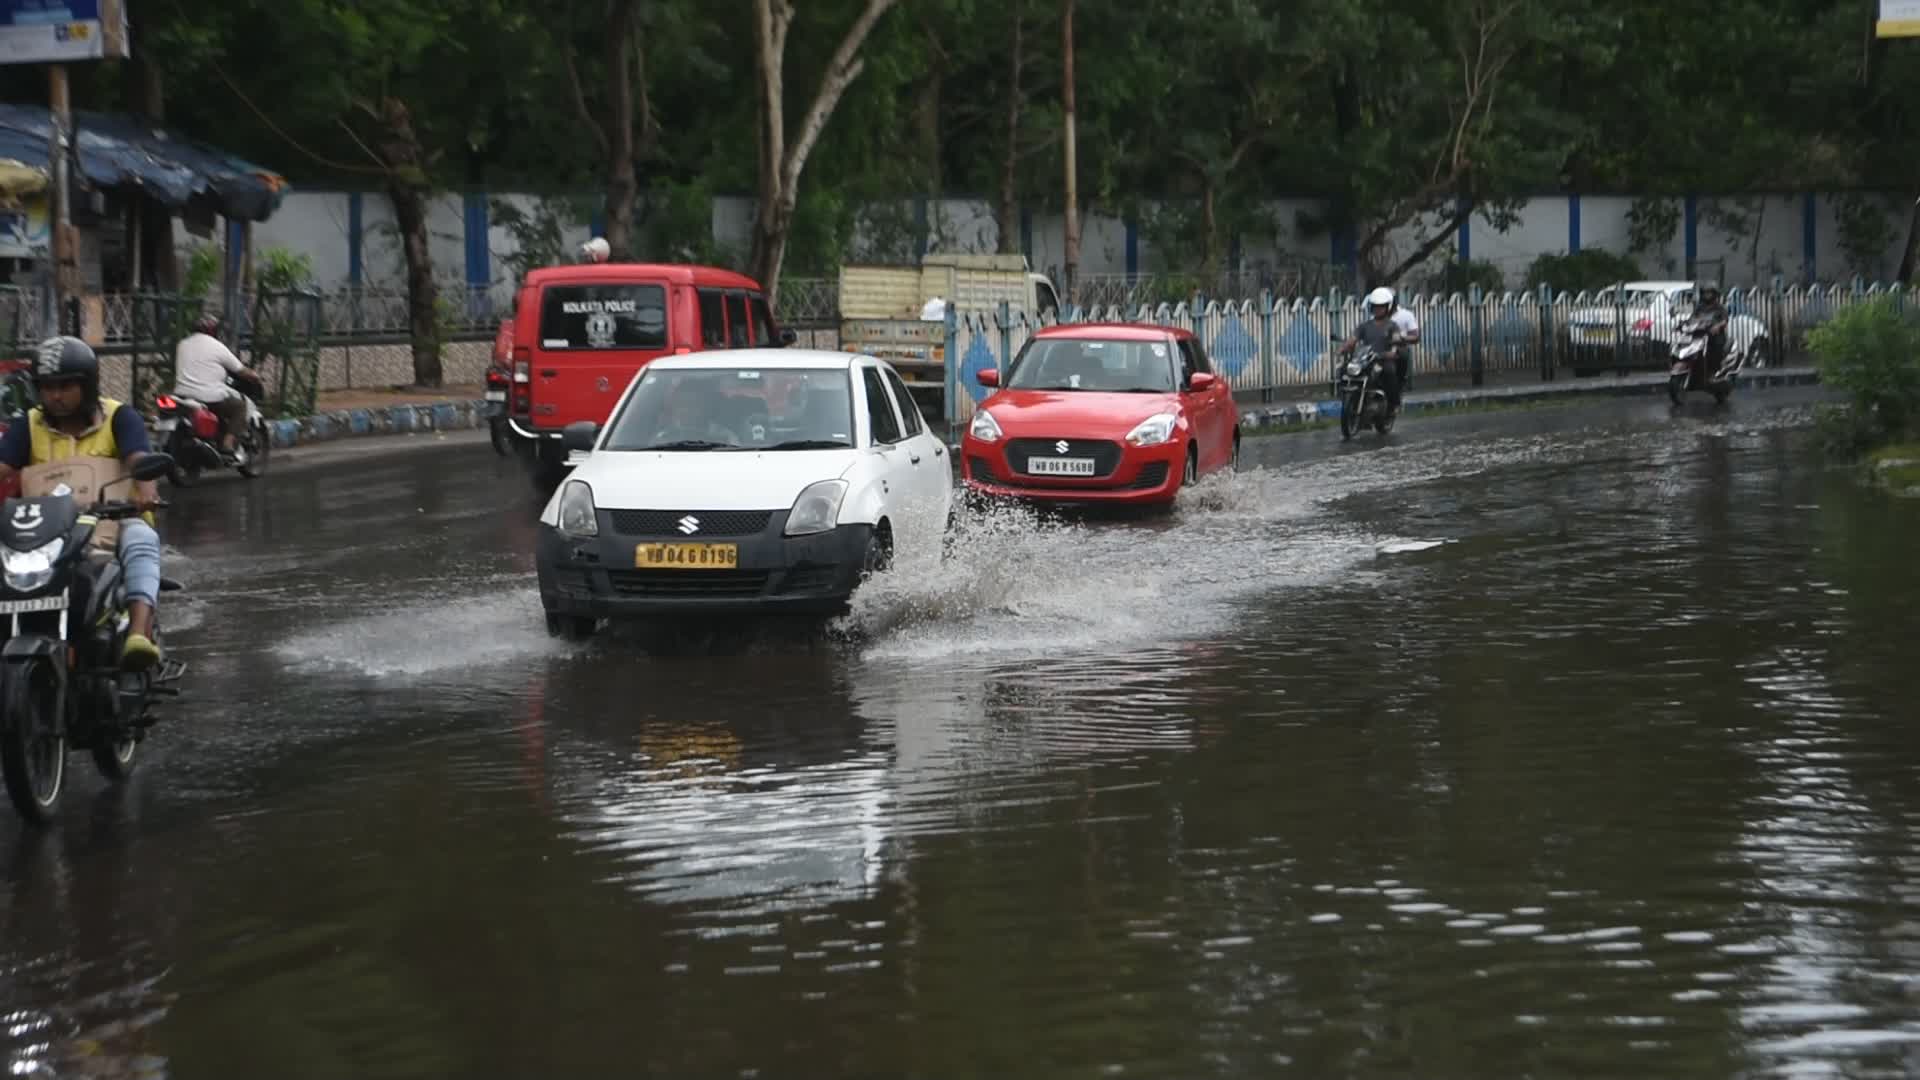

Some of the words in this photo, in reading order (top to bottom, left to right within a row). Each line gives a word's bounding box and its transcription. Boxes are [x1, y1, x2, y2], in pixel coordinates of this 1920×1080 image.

[563, 301, 603, 313] KOLKATA
[604, 300, 635, 312] POLICE
[1035, 461, 1047, 472] WB
[1049, 462, 1060, 472] 06
[667, 548, 685, 564] 04
[688, 548, 697, 563] G
